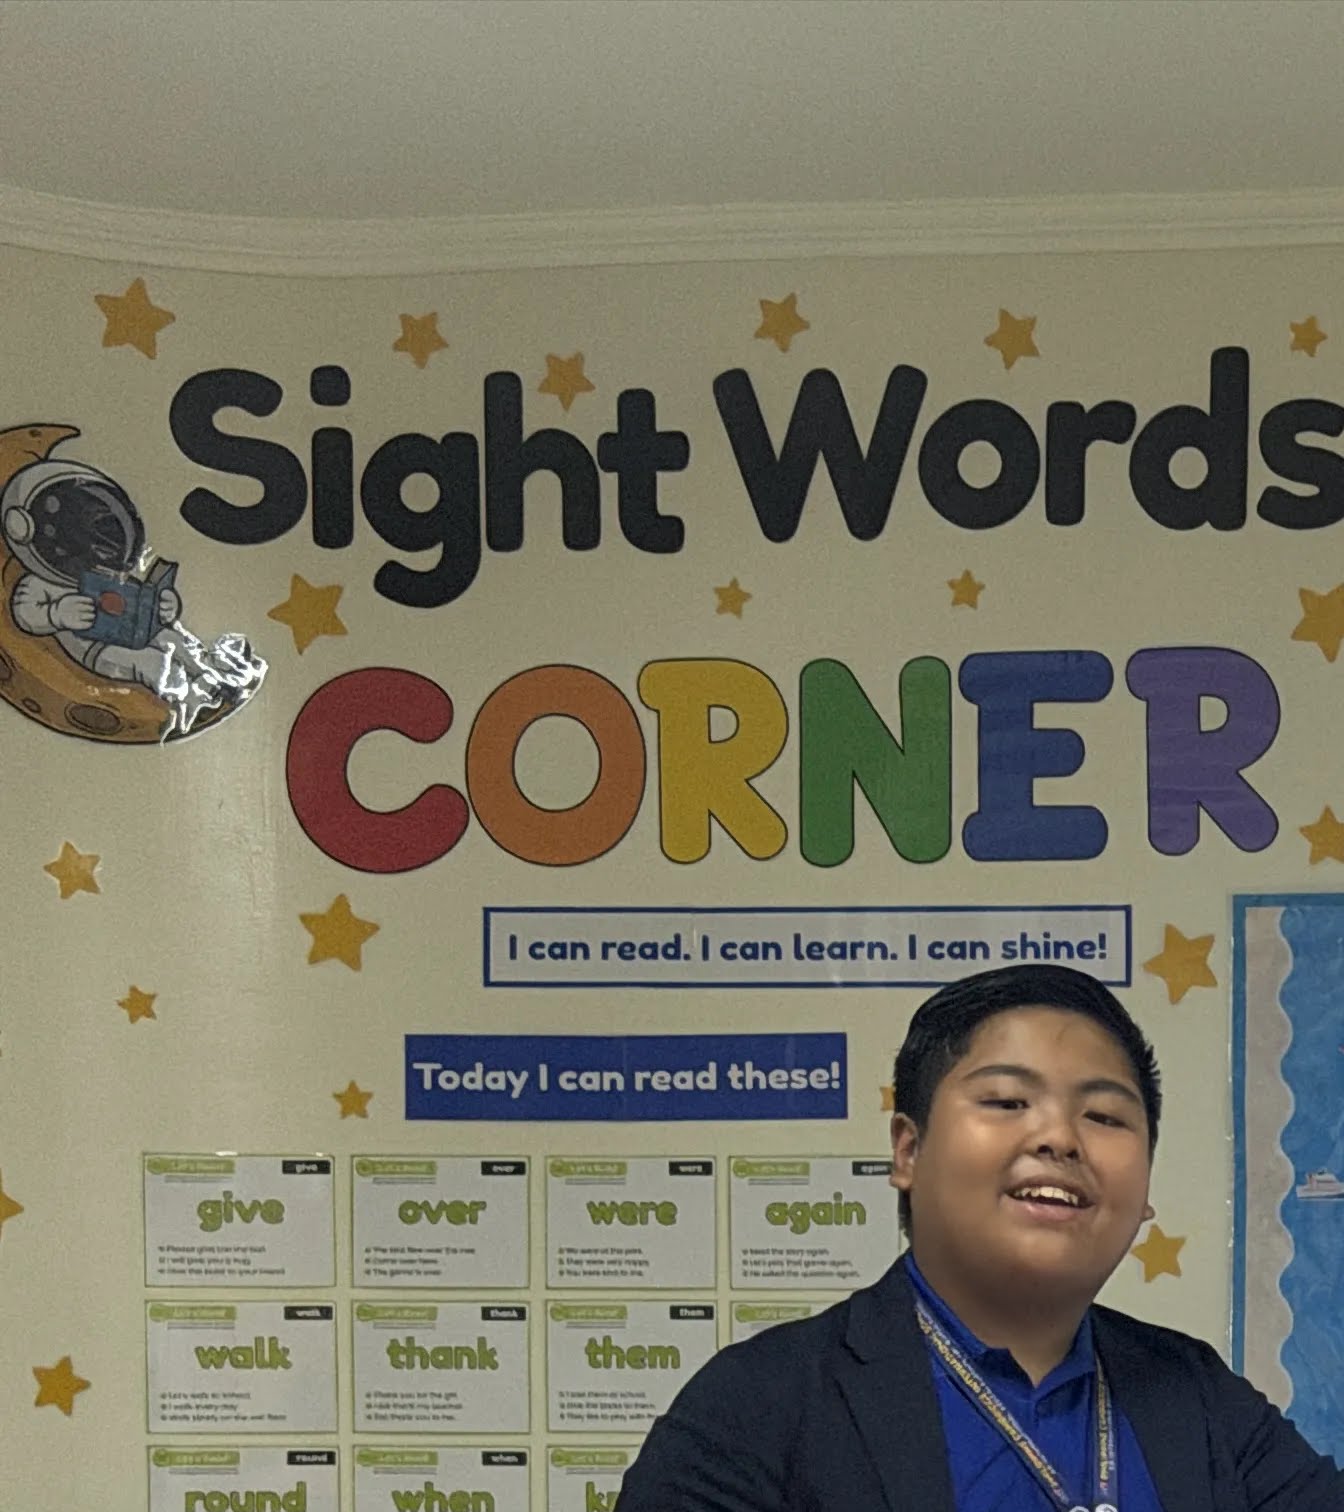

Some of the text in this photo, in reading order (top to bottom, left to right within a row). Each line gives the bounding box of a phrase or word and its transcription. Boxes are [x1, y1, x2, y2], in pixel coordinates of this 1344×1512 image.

[169, 365, 691, 608] Sight
[286, 646, 1281, 875] CORNER
[508, 933, 1107, 961] I can read. I can learn. I can shine!
[413, 1062, 840, 1098] Today I can read these!
[197, 1190, 285, 1232] give
[398, 1200, 487, 1225] over
[586, 1200, 678, 1226] were
[765, 1191, 867, 1235] again
[679, 1307, 705, 1316] them
[194, 1336, 293, 1370] walk
[386, 1336, 499, 1370] thank
[584, 1335, 681, 1369] them
